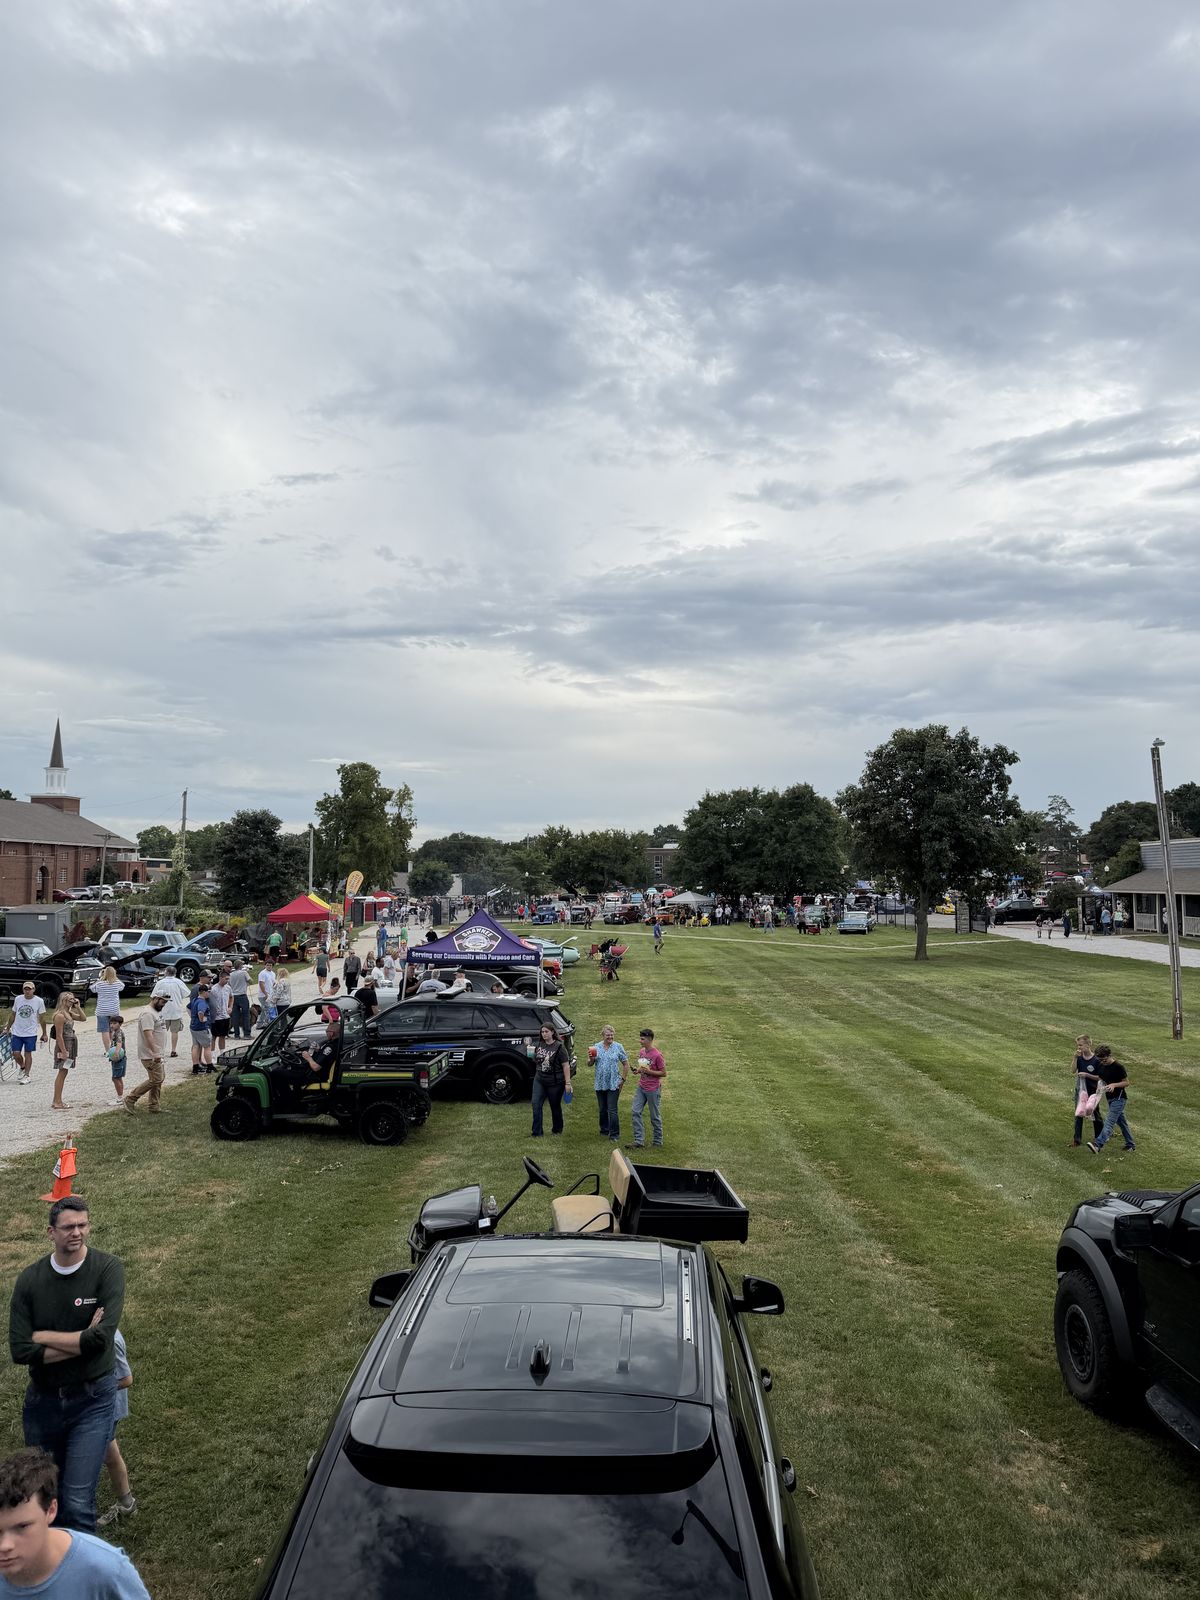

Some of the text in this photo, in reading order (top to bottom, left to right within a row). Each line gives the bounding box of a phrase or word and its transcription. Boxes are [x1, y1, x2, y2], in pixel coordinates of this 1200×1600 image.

[462, 928, 493, 937] SHAWNEE
[412, 951, 432, 959] Serving
[444, 952, 474, 960] Community
[488, 953, 510, 961] Purpose
